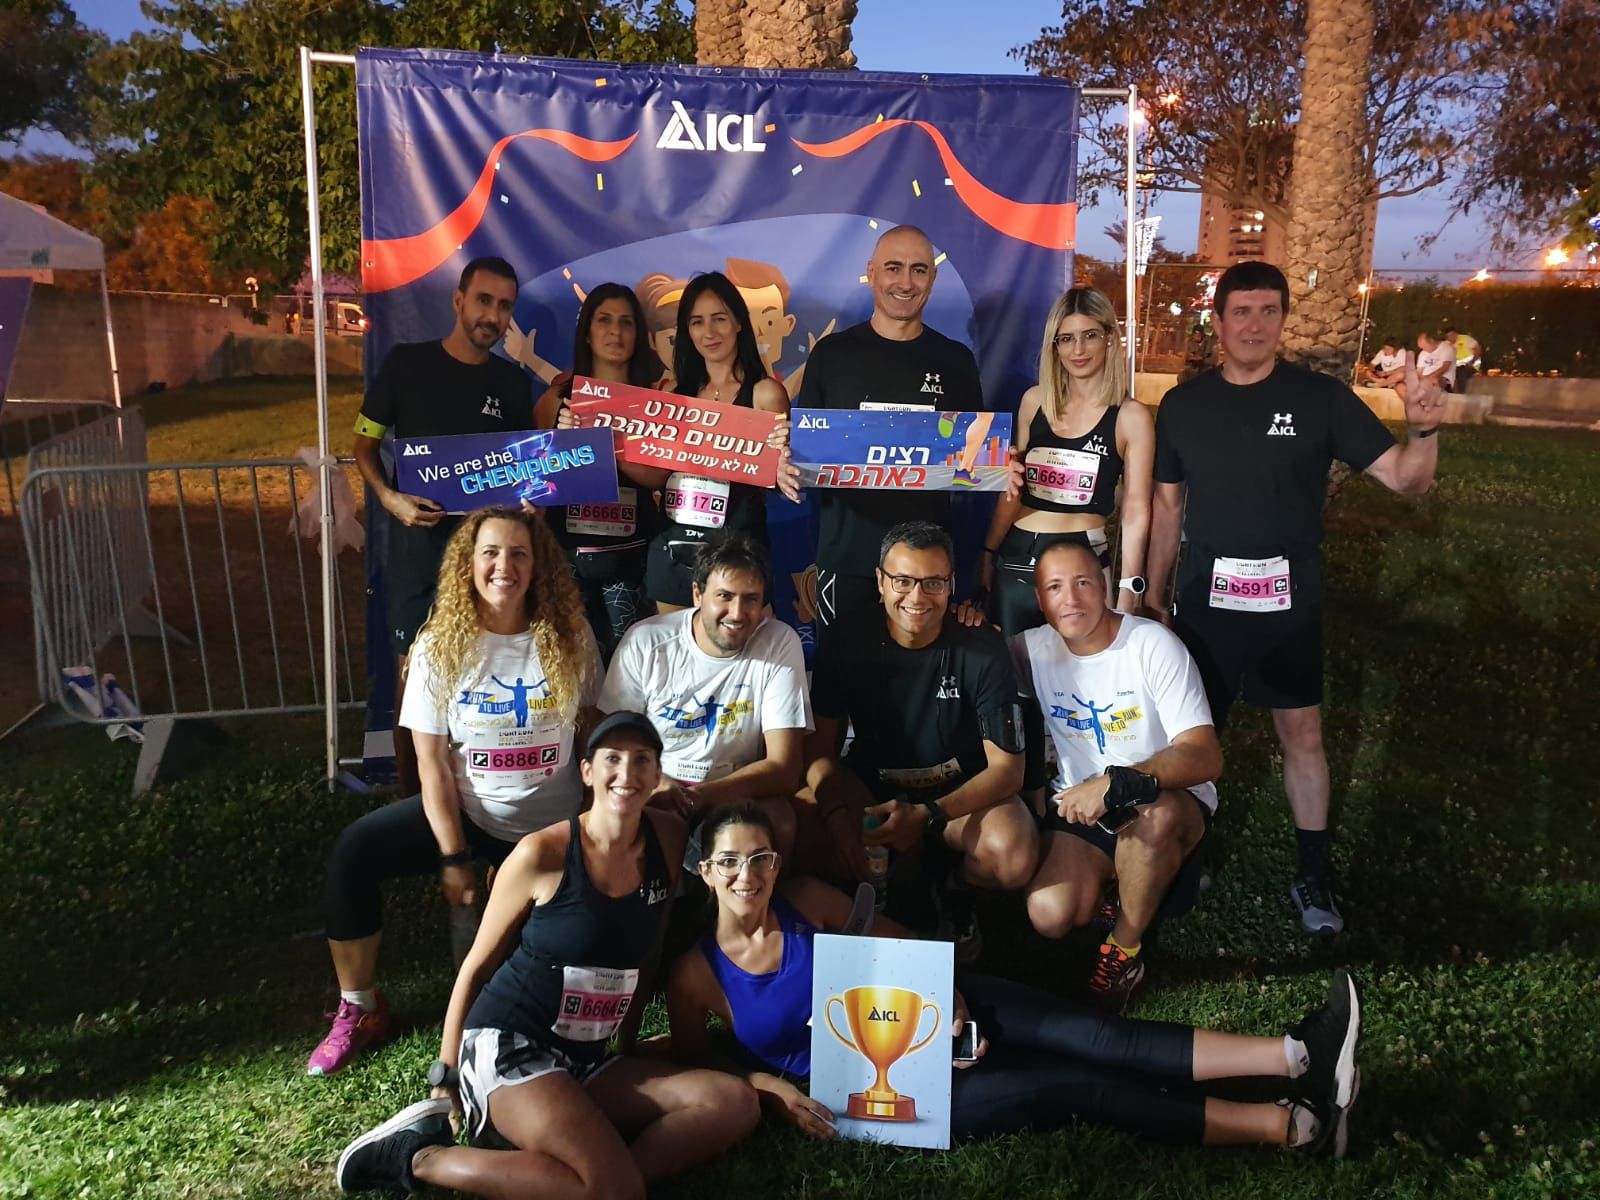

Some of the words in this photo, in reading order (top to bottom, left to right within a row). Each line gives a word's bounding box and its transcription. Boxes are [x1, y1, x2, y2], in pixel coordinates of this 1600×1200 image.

[644, 400, 721, 427] ספורט
[593, 412, 679, 442] באהבה
[639, 442, 674, 459] בכלל
[684, 429, 764, 456] עושים
[677, 451, 719, 467] עושים
[866, 446, 930, 464] רצים
[417, 466, 450, 483] We
[454, 457, 483, 475] are
[484, 450, 513, 467] the
[460, 444, 597, 495] CHEMPIONS
[722, 458, 741, 471] לא
[743, 462, 759, 474] או
[816, 465, 927, 487] באהבה
[1040, 469, 1077, 488] 6634
[676, 493, 709, 509] 617
[583, 505, 619, 520] 6666
[1231, 581, 1270, 596] 6591
[467, 692, 485, 705] RUN
[529, 698, 548, 710] LIVE
[483, 703, 492, 713] TO
[495, 702, 511, 713] LIVE
[1122, 709, 1137, 721] RUN
[1077, 719, 1090, 729] LIVE
[1116, 720, 1126, 731] TO
[493, 752, 538, 768] 6886
[583, 999, 618, 1017] 6664
